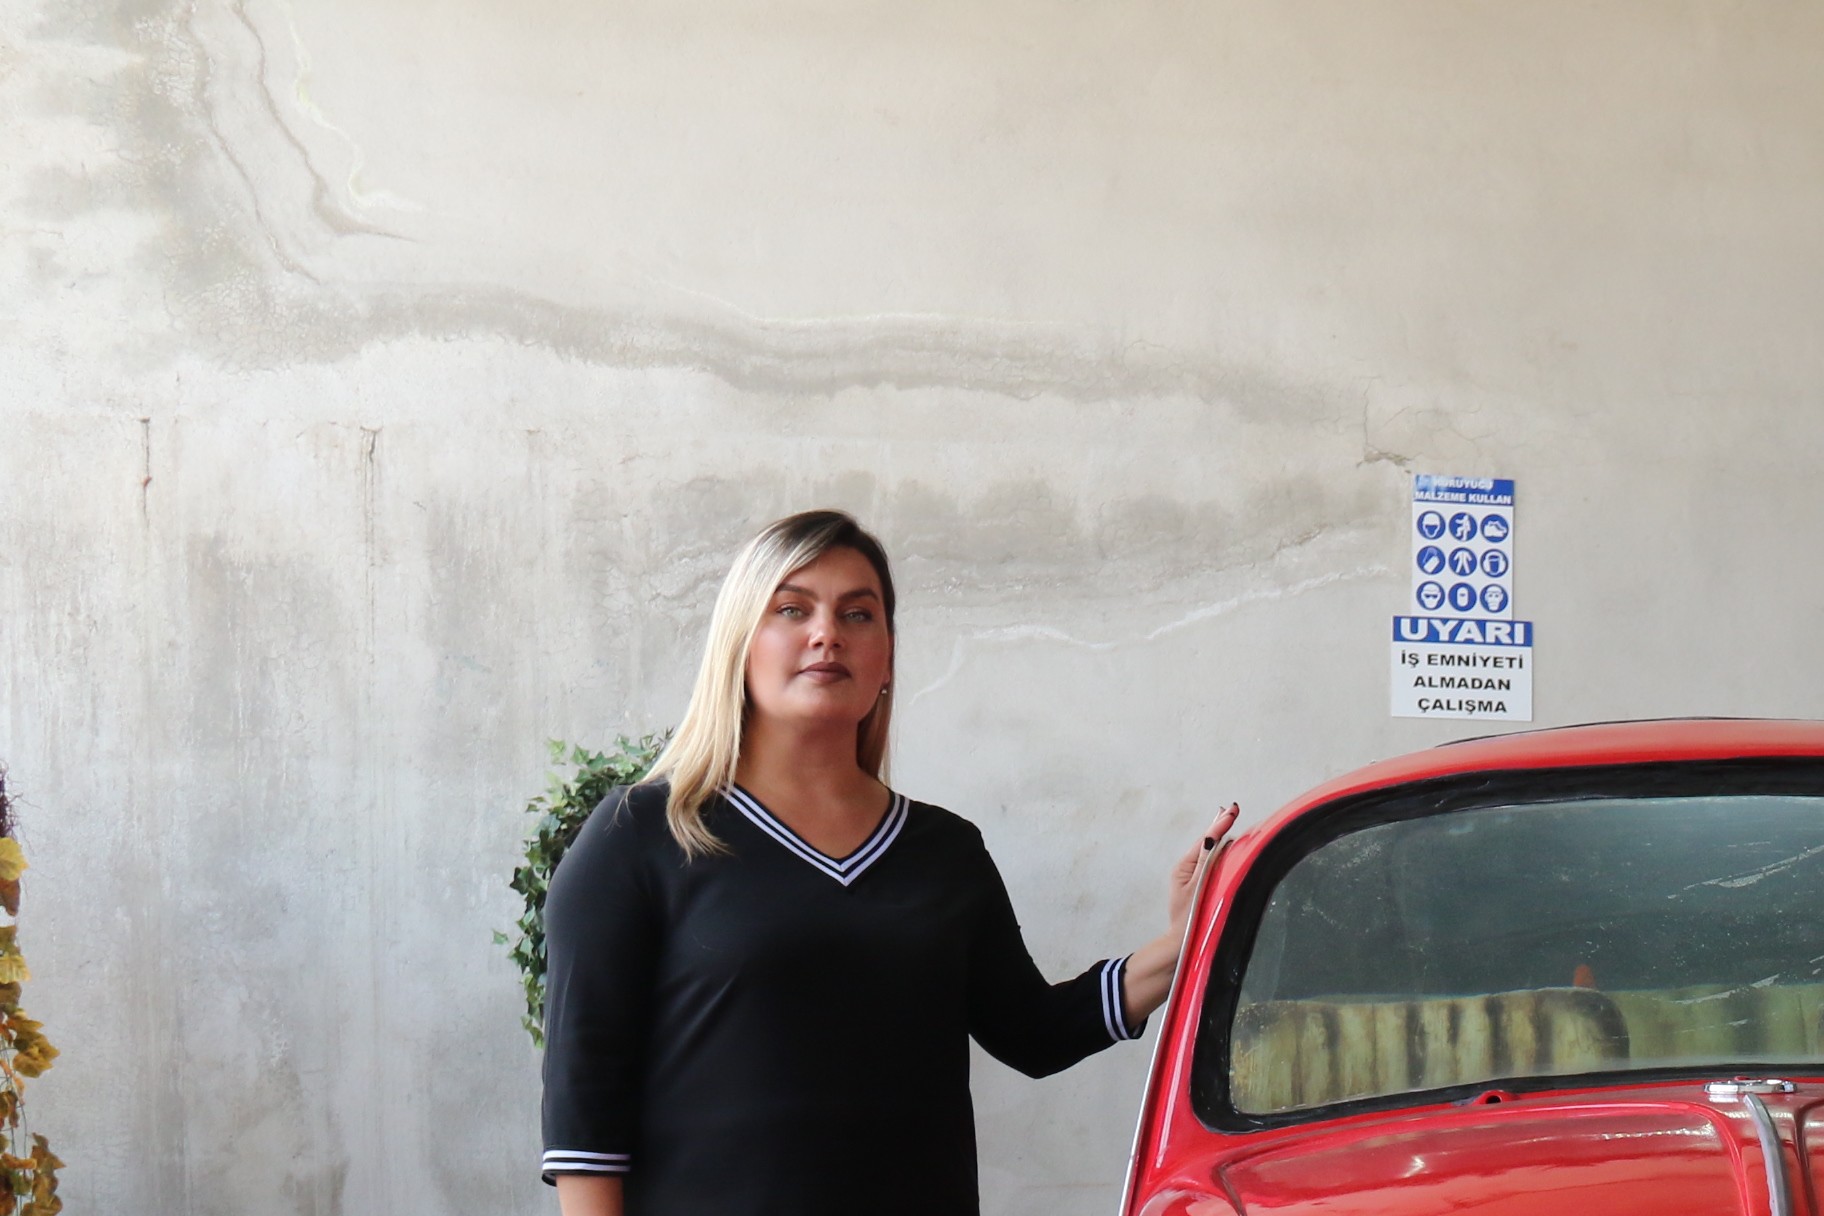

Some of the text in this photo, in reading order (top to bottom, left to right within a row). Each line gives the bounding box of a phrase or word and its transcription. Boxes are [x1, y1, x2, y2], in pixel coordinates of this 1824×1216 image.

[1414, 491, 1512, 504] MALZEME KULLAN
[1400, 618, 1525, 645] UYARI
[1401, 650, 1524, 670] İŞ EMNİYETİ
[1413, 676, 1512, 691] ALMADAN
[1418, 698, 1508, 716] ÇALIŞMA
